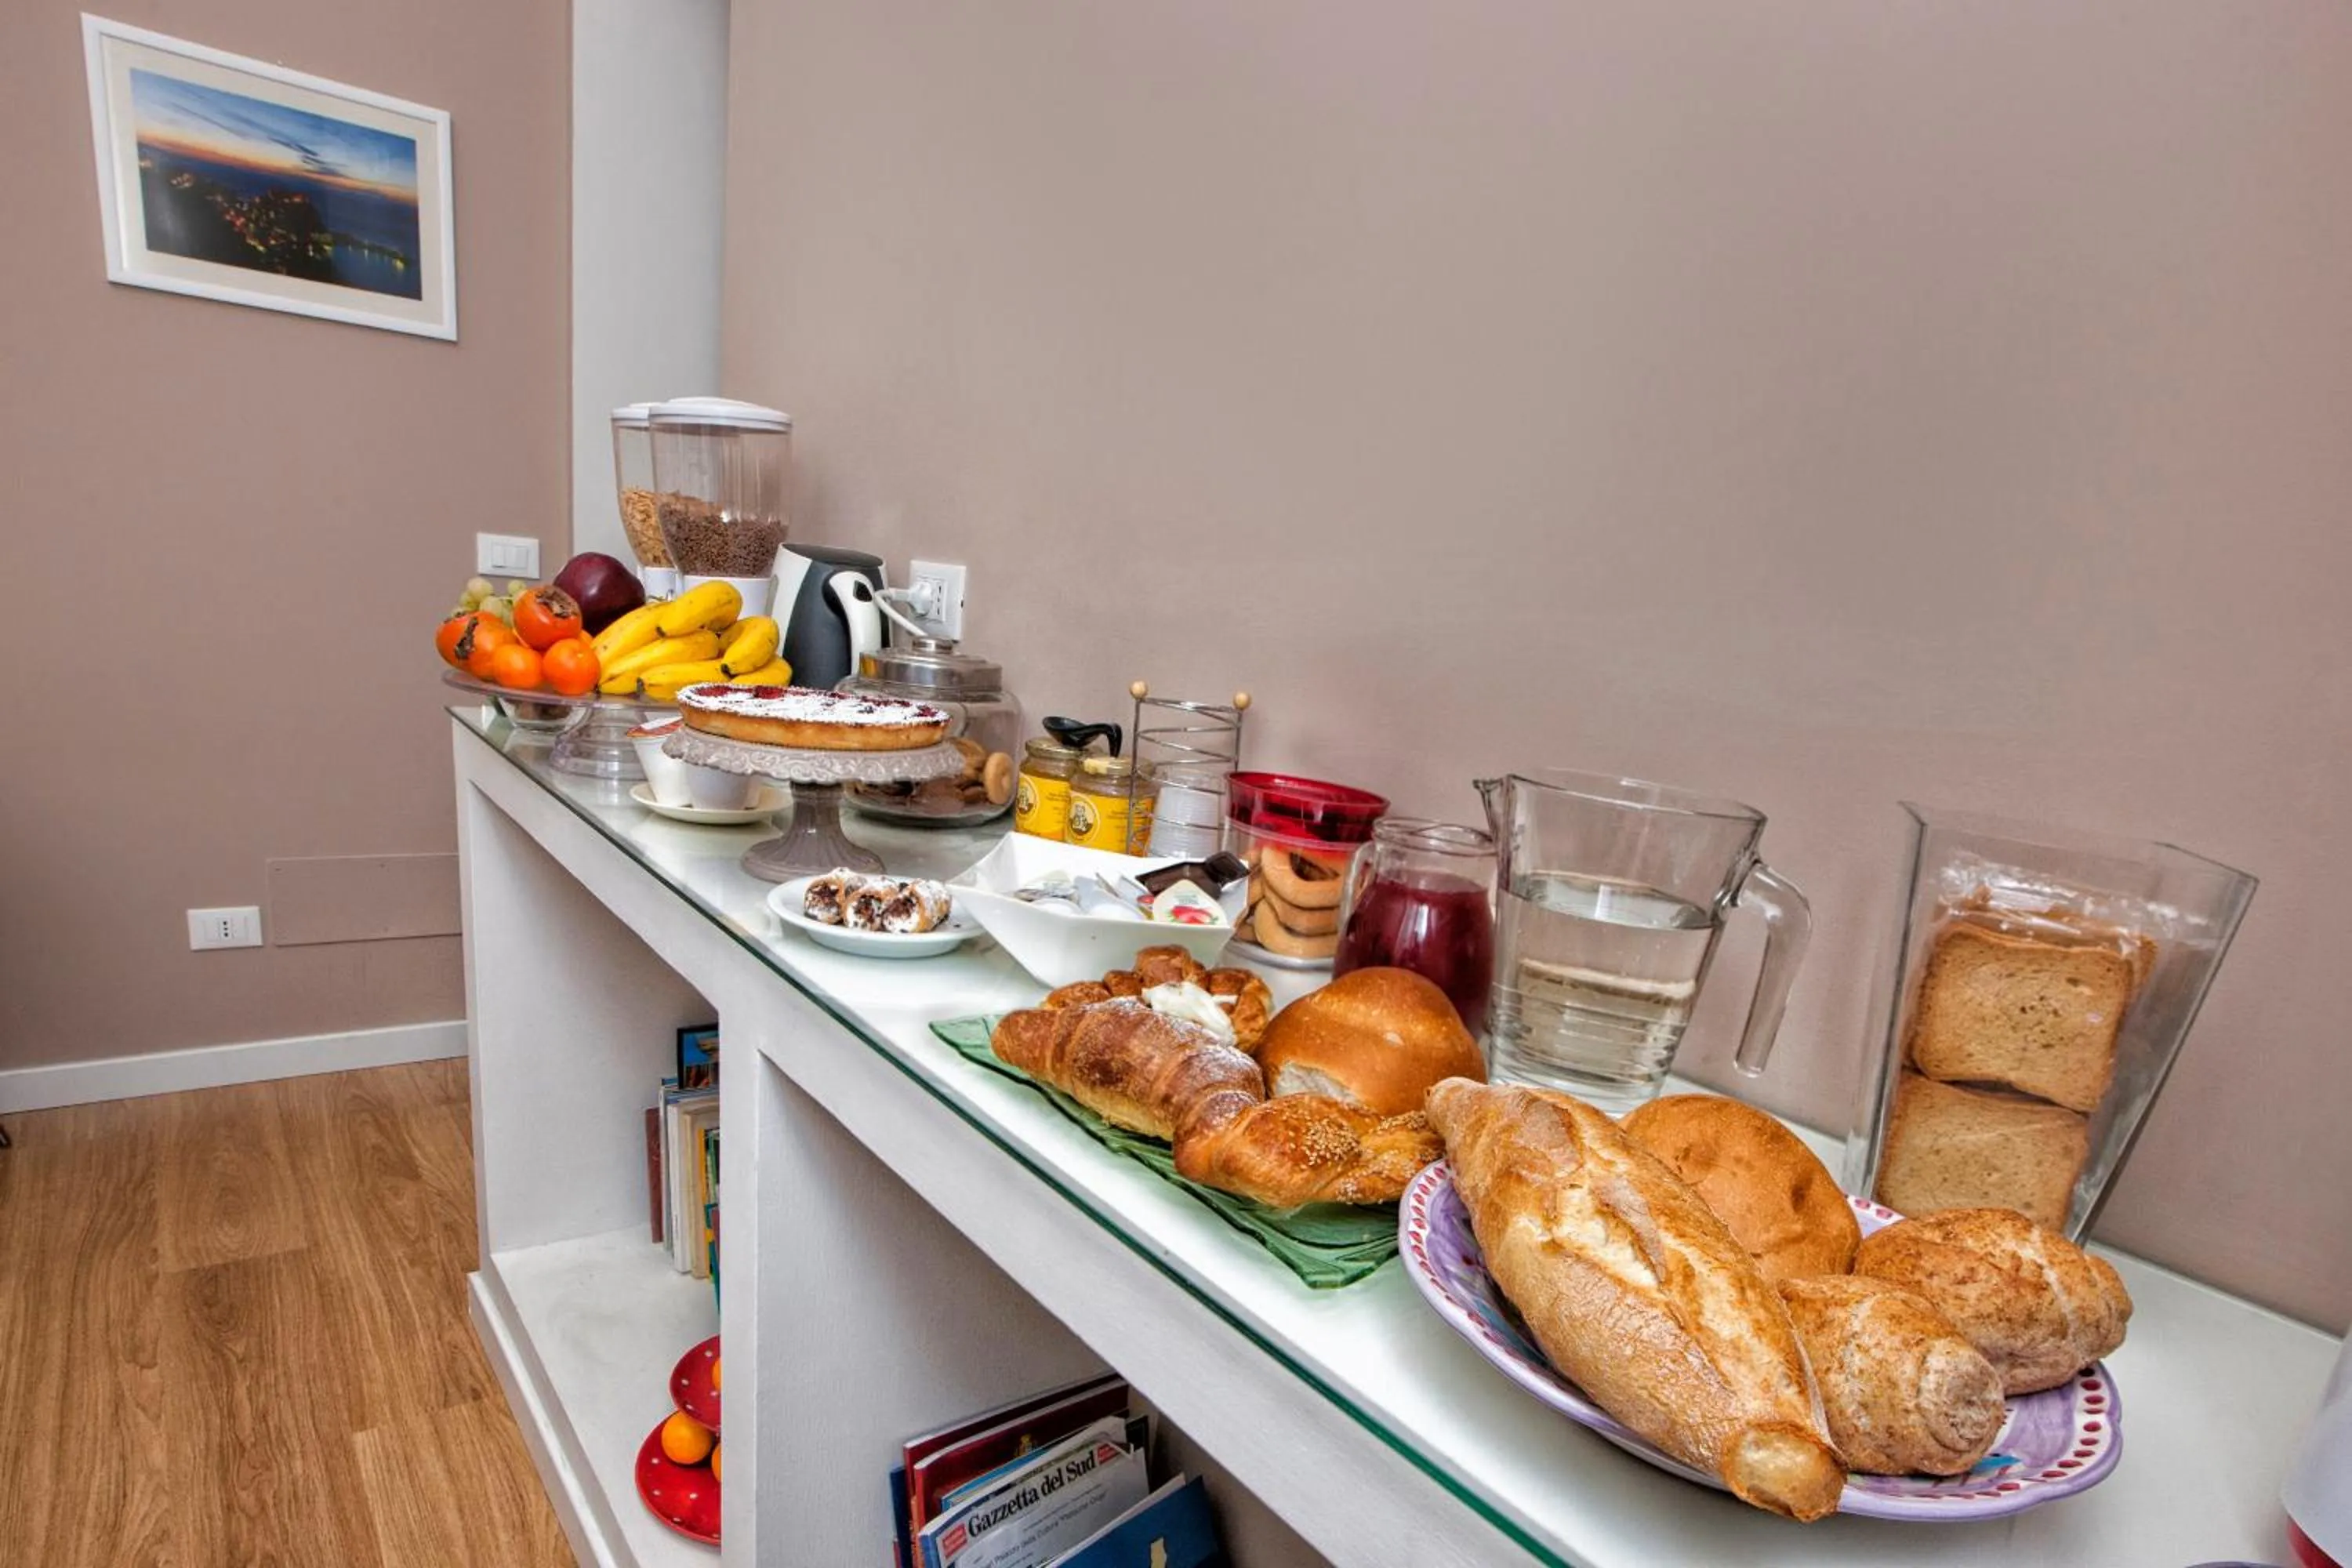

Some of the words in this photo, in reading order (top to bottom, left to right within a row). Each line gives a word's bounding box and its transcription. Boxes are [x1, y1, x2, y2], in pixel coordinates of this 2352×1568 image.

[968, 1486, 1040, 1537] Gazzetta
[1041, 1469, 1064, 1494] del
[1066, 1450, 1095, 1482] Sud
